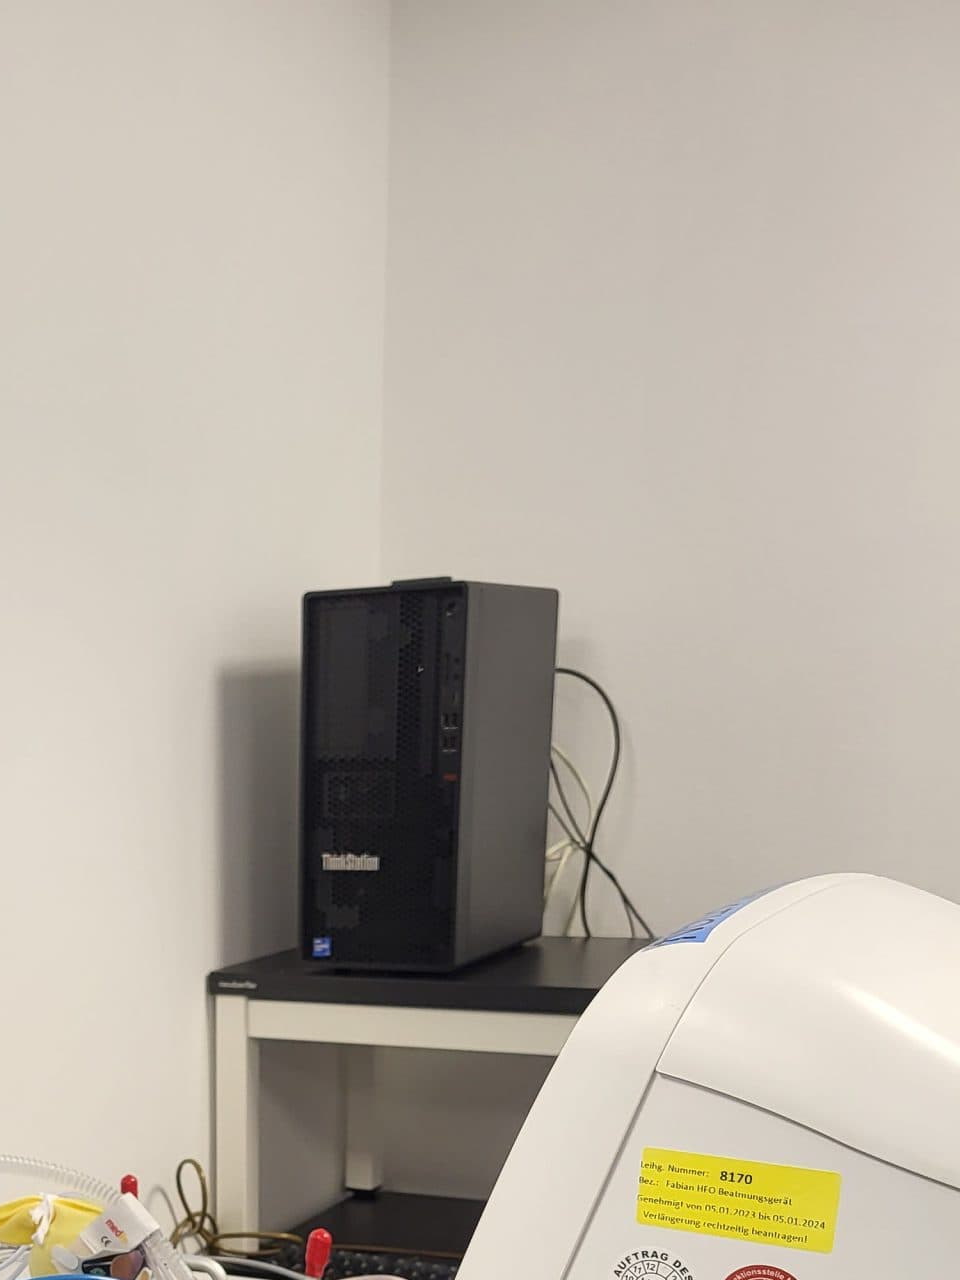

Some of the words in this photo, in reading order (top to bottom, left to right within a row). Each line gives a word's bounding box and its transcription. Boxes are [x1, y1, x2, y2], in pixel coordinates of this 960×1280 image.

[668, 1164, 710, 1177] Nummer:
[719, 1170, 753, 1185] 8170
[666, 1180, 694, 1191] Fabian
[697, 1185, 716, 1194] HFO
[718, 1188, 792, 1206] Beatmungsgerät
[643, 1210, 701, 1229] Verlängerung
[703, 1221, 749, 1236] rechtzeitig
[686, 1203, 702, 1211] von
[704, 1204, 756, 1218] 05.01.2023
[758, 1211, 771, 1221] bis
[772, 1214, 826, 1230] 05.01.2024
[614, 1250, 669, 1277] AUFTRAG
[645, 1262, 656, 1271] 12
